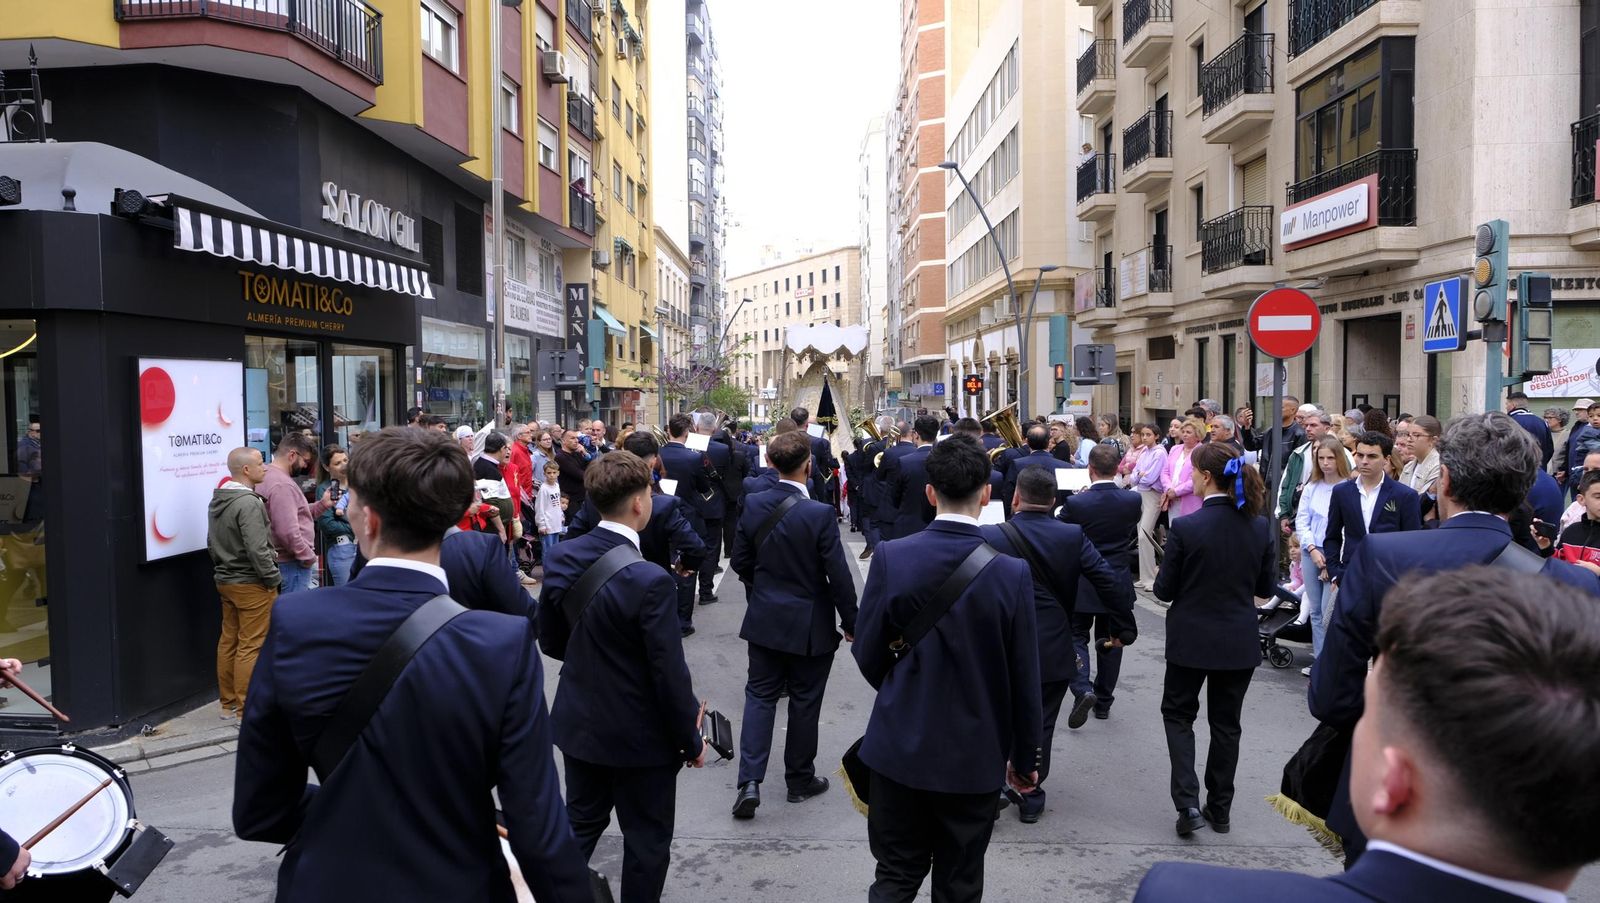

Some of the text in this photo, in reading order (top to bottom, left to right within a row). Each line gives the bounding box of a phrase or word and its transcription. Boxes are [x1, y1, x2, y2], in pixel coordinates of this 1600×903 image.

[1303, 199, 1359, 231] Manpower
[239, 270, 353, 316] TOMATI&Co
[285, 316, 318, 329] PREMIUM
[320, 321, 345, 332] CHERRY
[168, 433, 222, 447] TOMATI&Co
